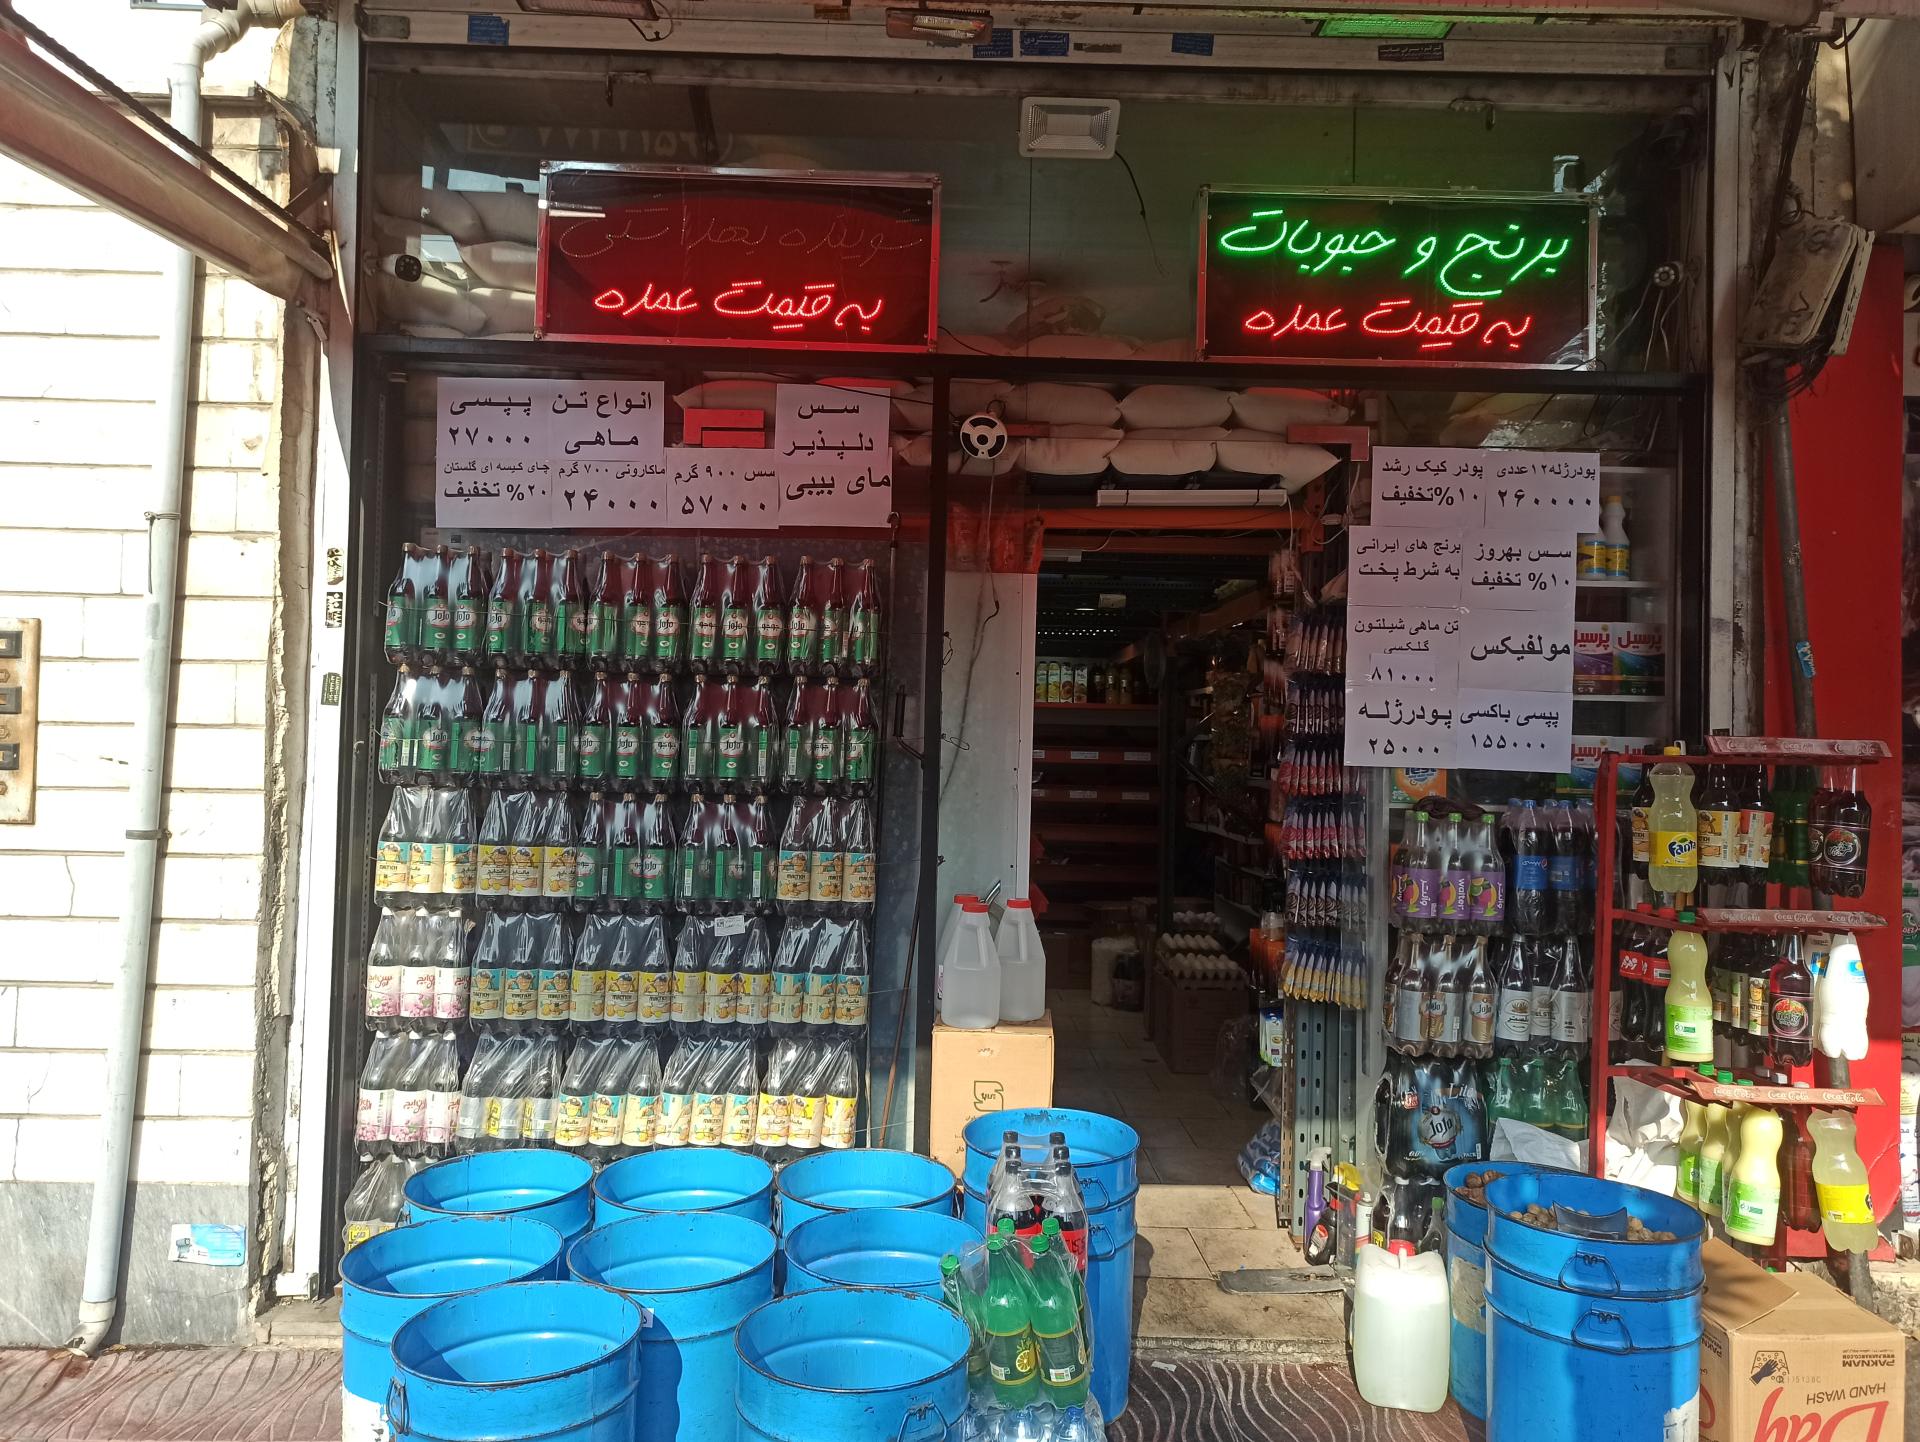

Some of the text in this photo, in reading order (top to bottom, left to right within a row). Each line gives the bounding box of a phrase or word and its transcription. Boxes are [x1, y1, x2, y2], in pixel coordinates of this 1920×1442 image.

[1219, 209, 1569, 297] برنج و حبوبات
[594, 280, 884, 331] به قیمت عمده
[1244, 300, 1532, 350] به قیمت عمده
[449, 395, 533, 417] پپسی
[551, 390, 652, 419] انواع تن
[797, 400, 860, 420] سس
[448, 426, 531, 446] ۲۷۰۰۰
[564, 428, 640, 455] ماهی
[782, 429, 874, 460] دلپذیر
[443, 460, 551, 475] چای کیسه ای گلستان
[558, 461, 666, 479] ماکارونی ۷۰۰ گرم
[674, 464, 776, 485] سس ۹۰۰ گرم
[1381, 458, 1485, 480] پودر کیک رشد
[443, 481, 500, 502] تخفیف
[785, 466, 892, 500] مای بیبی
[563, 488, 659, 512] ۲۴۰۰۰
[681, 494, 767, 515] ۵۷۰۰۰
[1381, 485, 1434, 506] تخفیف
[1497, 488, 1592, 508] ۲۶۰۰۰۰
[1356, 537, 1462, 555] برنج های ایرانی
[1473, 542, 1572, 562] سس بهروز
[1358, 561, 1461, 583] به شرط پخت
[1471, 571, 1521, 592] تخفیف
[1354, 617, 1460, 635] تن ماهی شیلتون
[1383, 640, 1431, 655] گلکسی
[1470, 634, 1571, 662] مولفیکس
[1371, 666, 1435, 684] ۸۱۰۰۰
[1357, 698, 1453, 729] پودرژله
[1460, 703, 1560, 728] پپسی باکسی
[1368, 737, 1440, 755] ۲۵۰۰۰
[1471, 733, 1546, 751] ۱۵۵۰۰۰
[1430, 1116, 1454, 1138] JoJo
[1841, 1358, 1896, 1367] PAKNAM
[1806, 1382, 1887, 1406] HAND WASH
